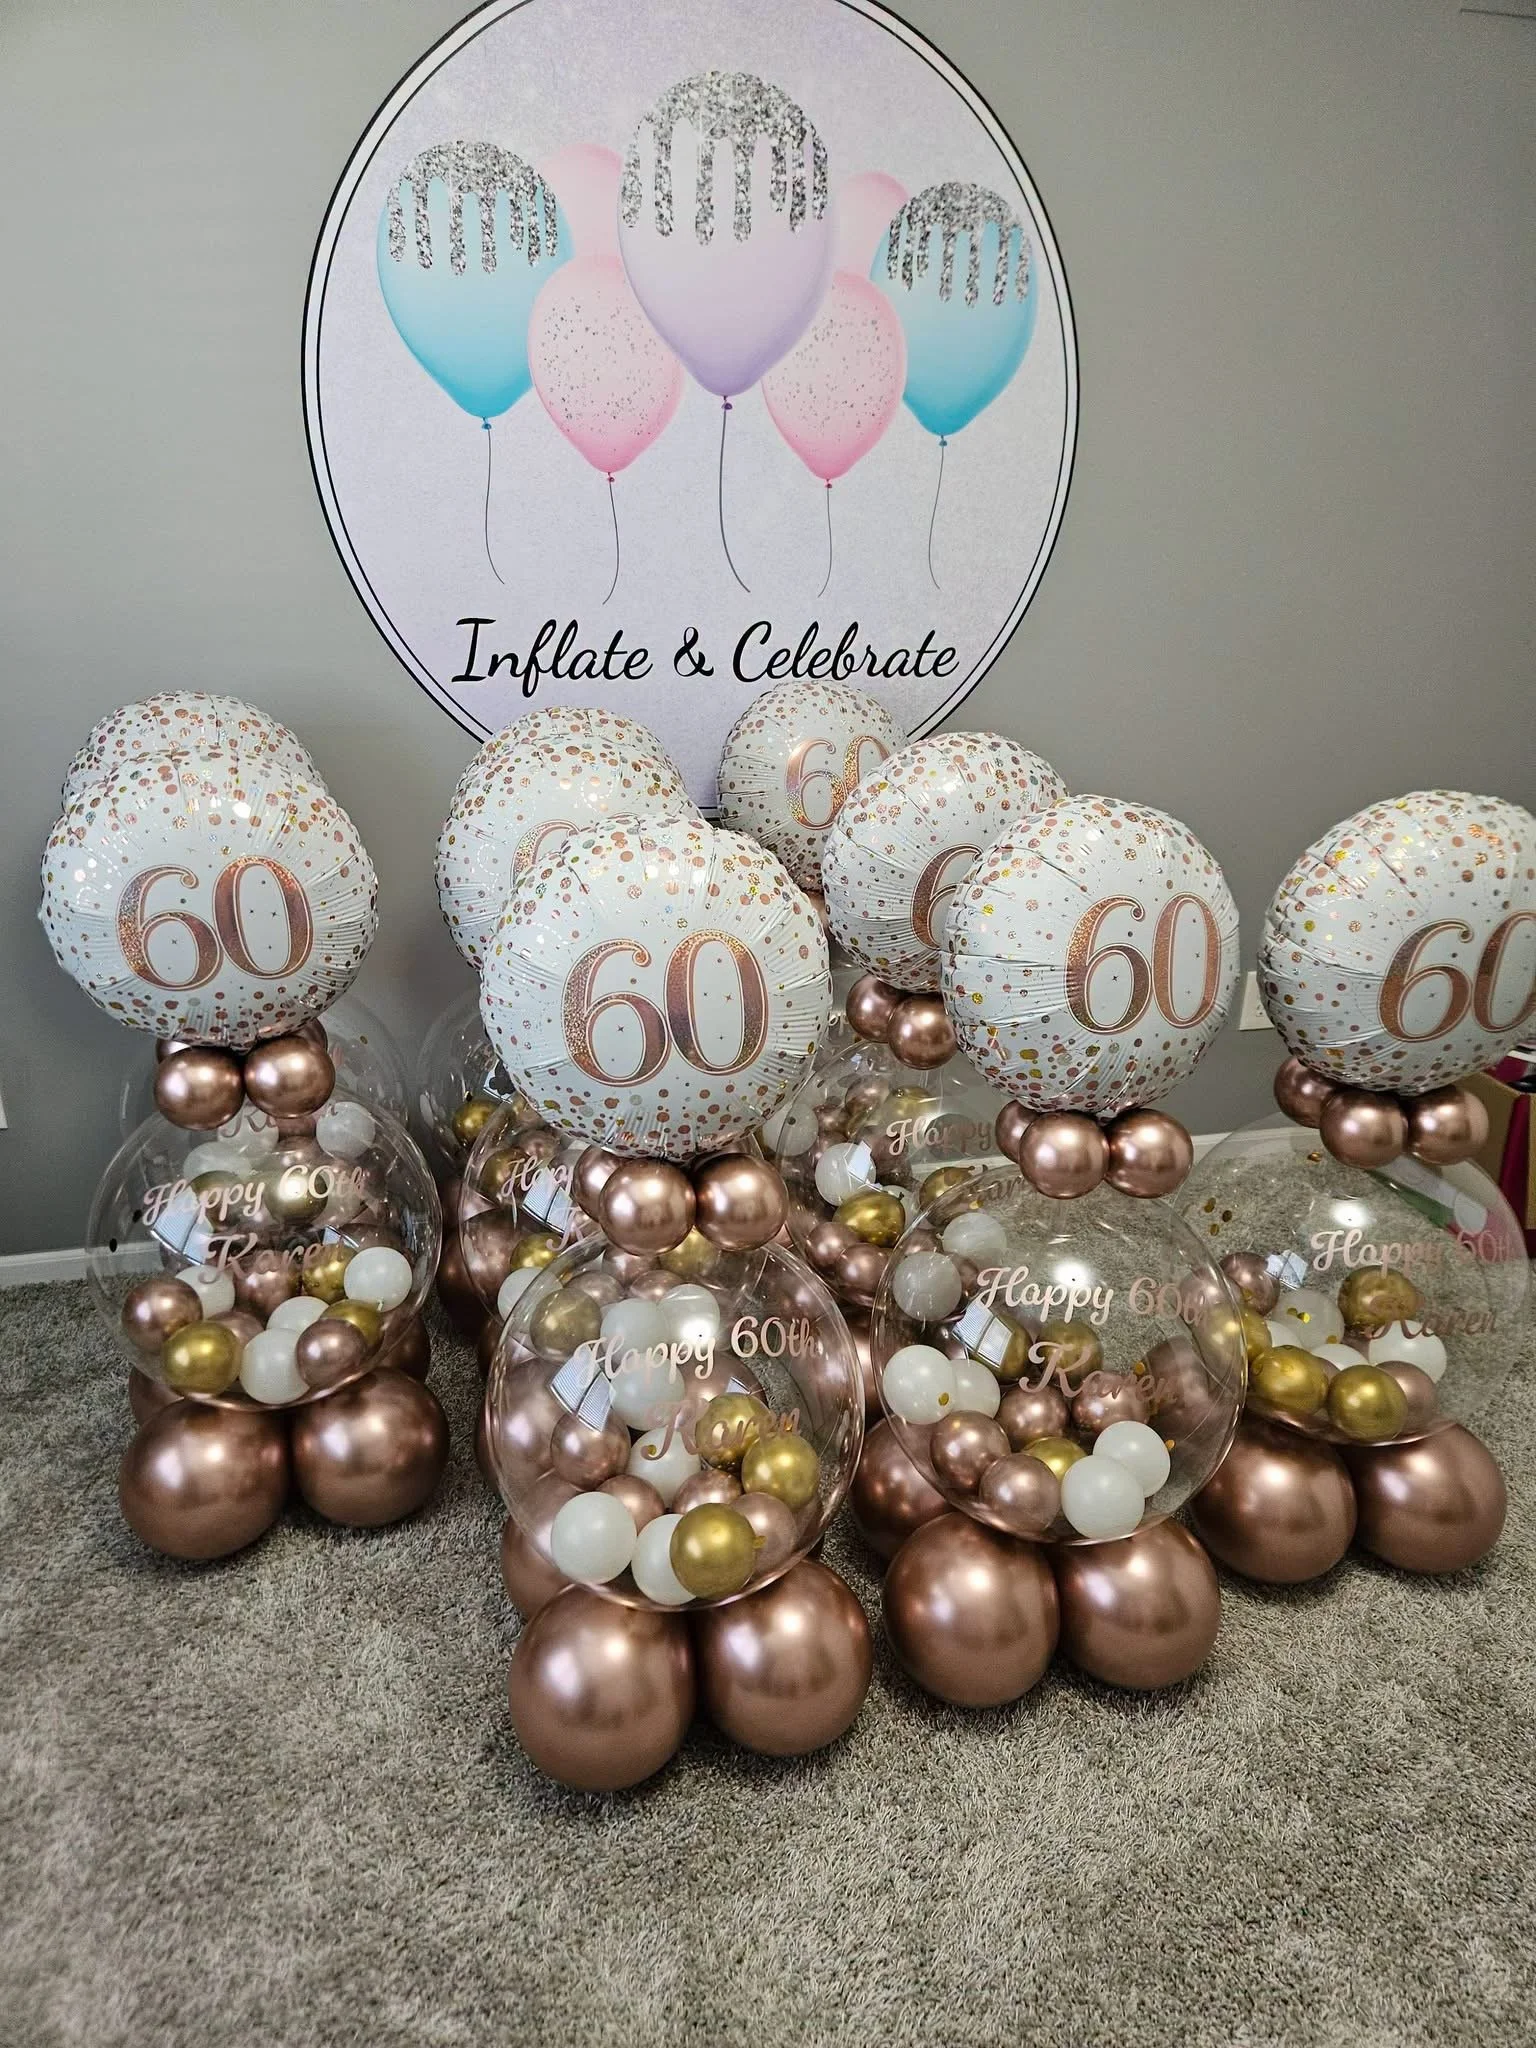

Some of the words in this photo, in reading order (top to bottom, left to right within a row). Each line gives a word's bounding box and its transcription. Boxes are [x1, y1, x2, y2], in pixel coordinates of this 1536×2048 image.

[451, 617, 653, 698] Inflate
[673, 626, 715, 678] &
[731, 620, 960, 682] Celebrate
[115, 856, 315, 991] 60
[911, 843, 983, 950] 6
[561, 929, 769, 1088] 60
[1064, 892, 1222, 1035] 60
[1376, 910, 1536, 1043] 60
[886, 1115, 992, 1155] Happy
[142, 1178, 266, 1233] Happy
[976, 1266, 1114, 1326] Happy
[573, 1334, 717, 1388] Happy
[731, 1316, 819, 1358] 60th
